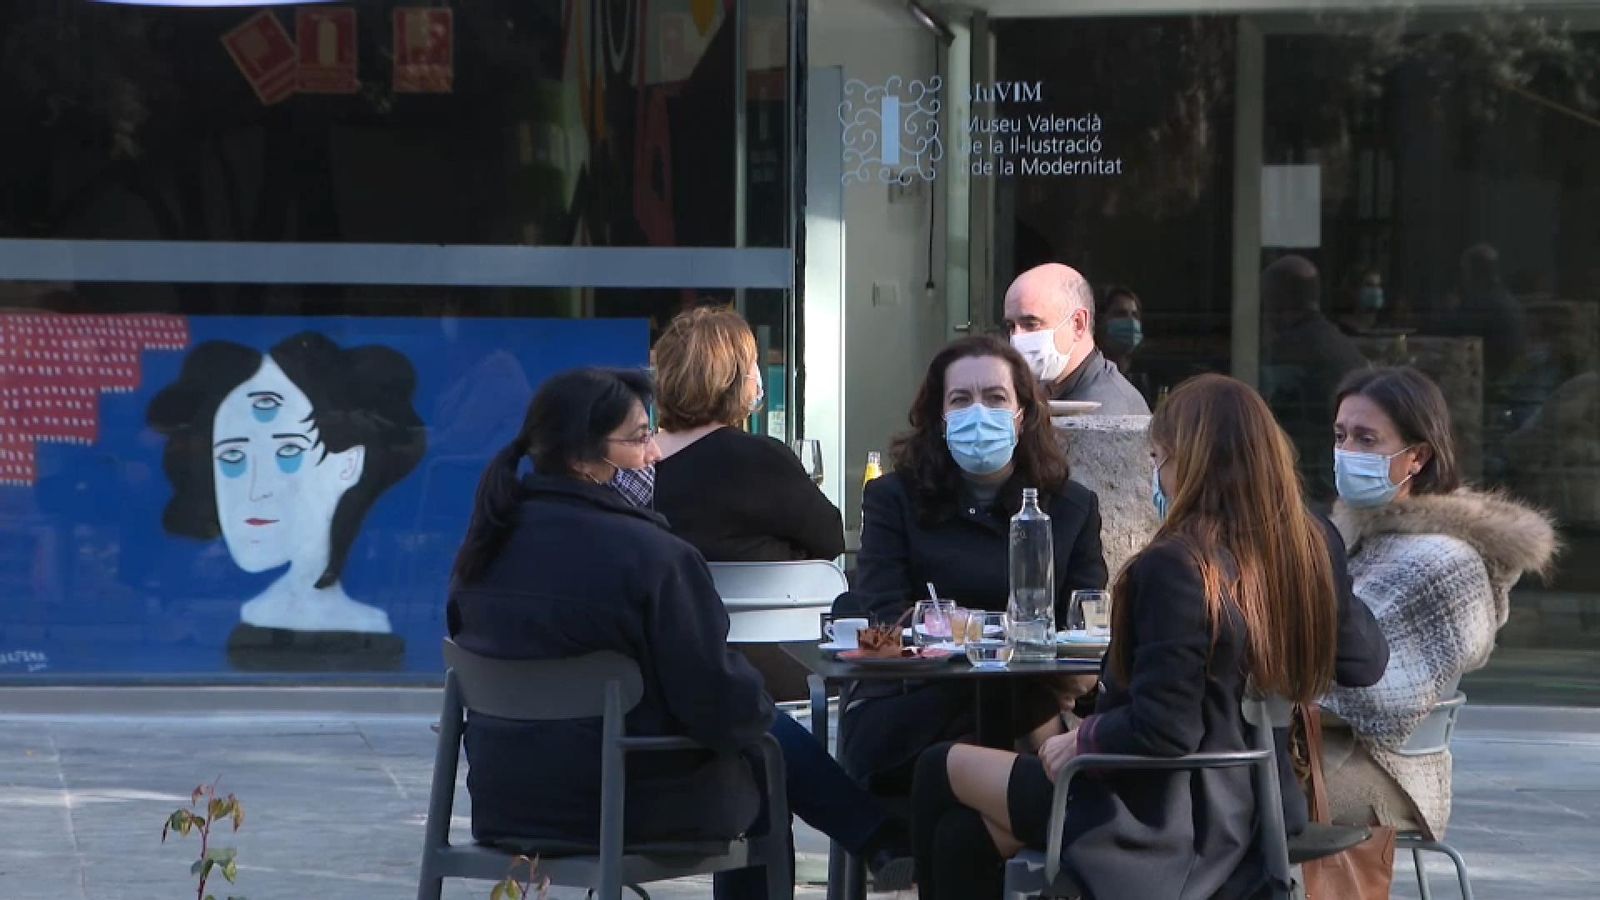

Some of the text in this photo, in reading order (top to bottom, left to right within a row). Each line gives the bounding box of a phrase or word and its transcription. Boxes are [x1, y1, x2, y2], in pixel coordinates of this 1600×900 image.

[1027, 112, 1101, 132] Valencià
[989, 134, 1004, 154] la
[971, 156, 993, 175] de
[1000, 157, 1014, 175] la
[1021, 156, 1122, 175] Modernitat
